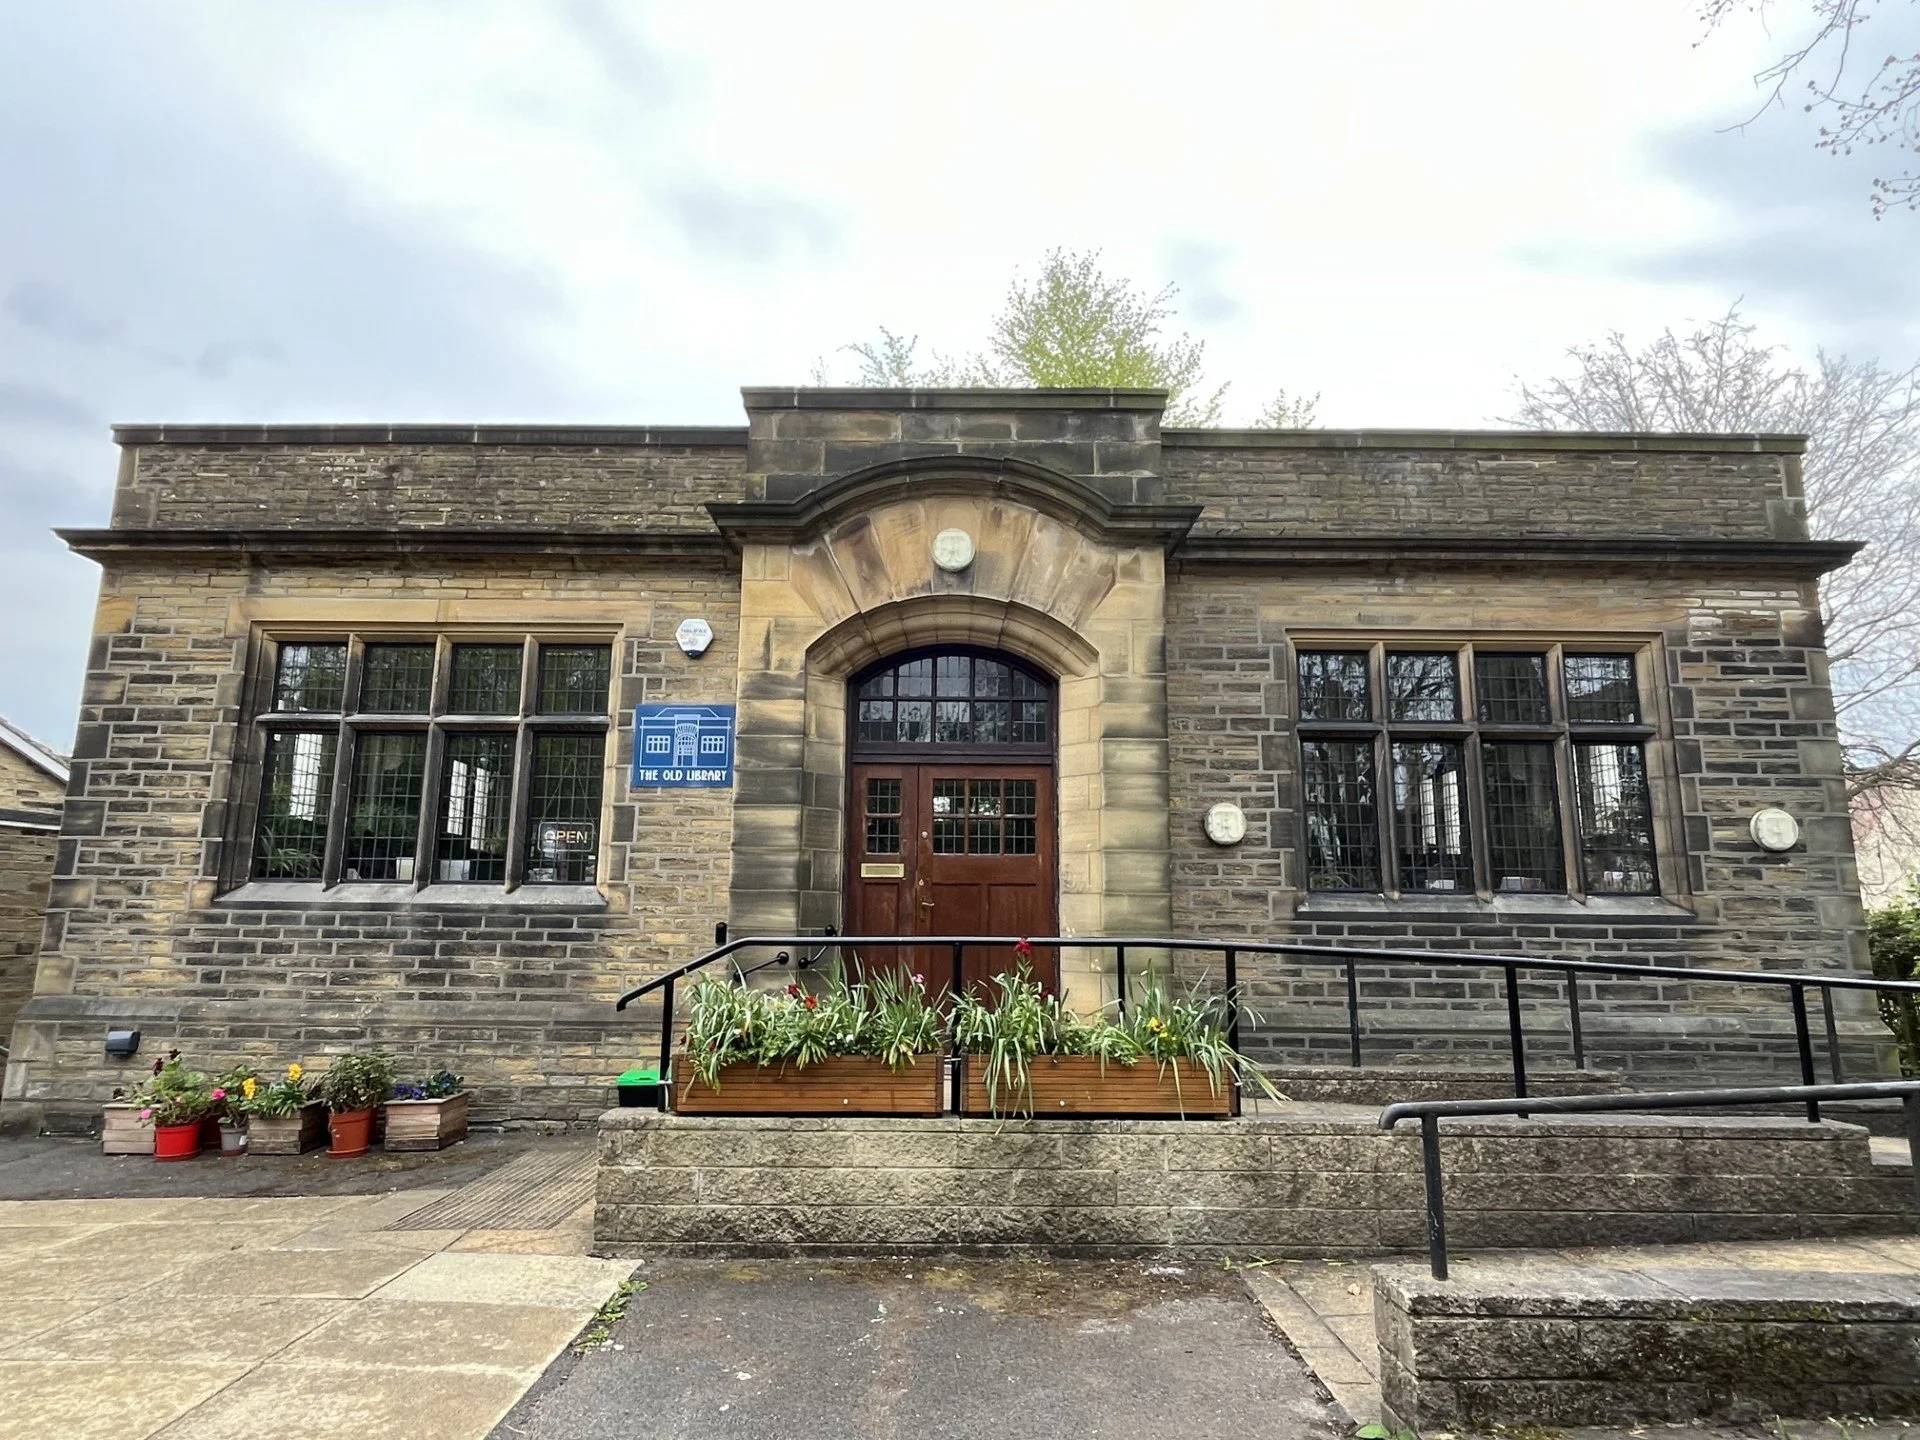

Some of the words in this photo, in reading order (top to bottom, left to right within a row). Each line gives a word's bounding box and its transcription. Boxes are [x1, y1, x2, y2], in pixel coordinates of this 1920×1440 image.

[640, 770, 658, 781] THE
[663, 770, 682, 781] OLD
[687, 770, 727, 781] LIBRARY
[545, 830, 587, 843] OPEN
